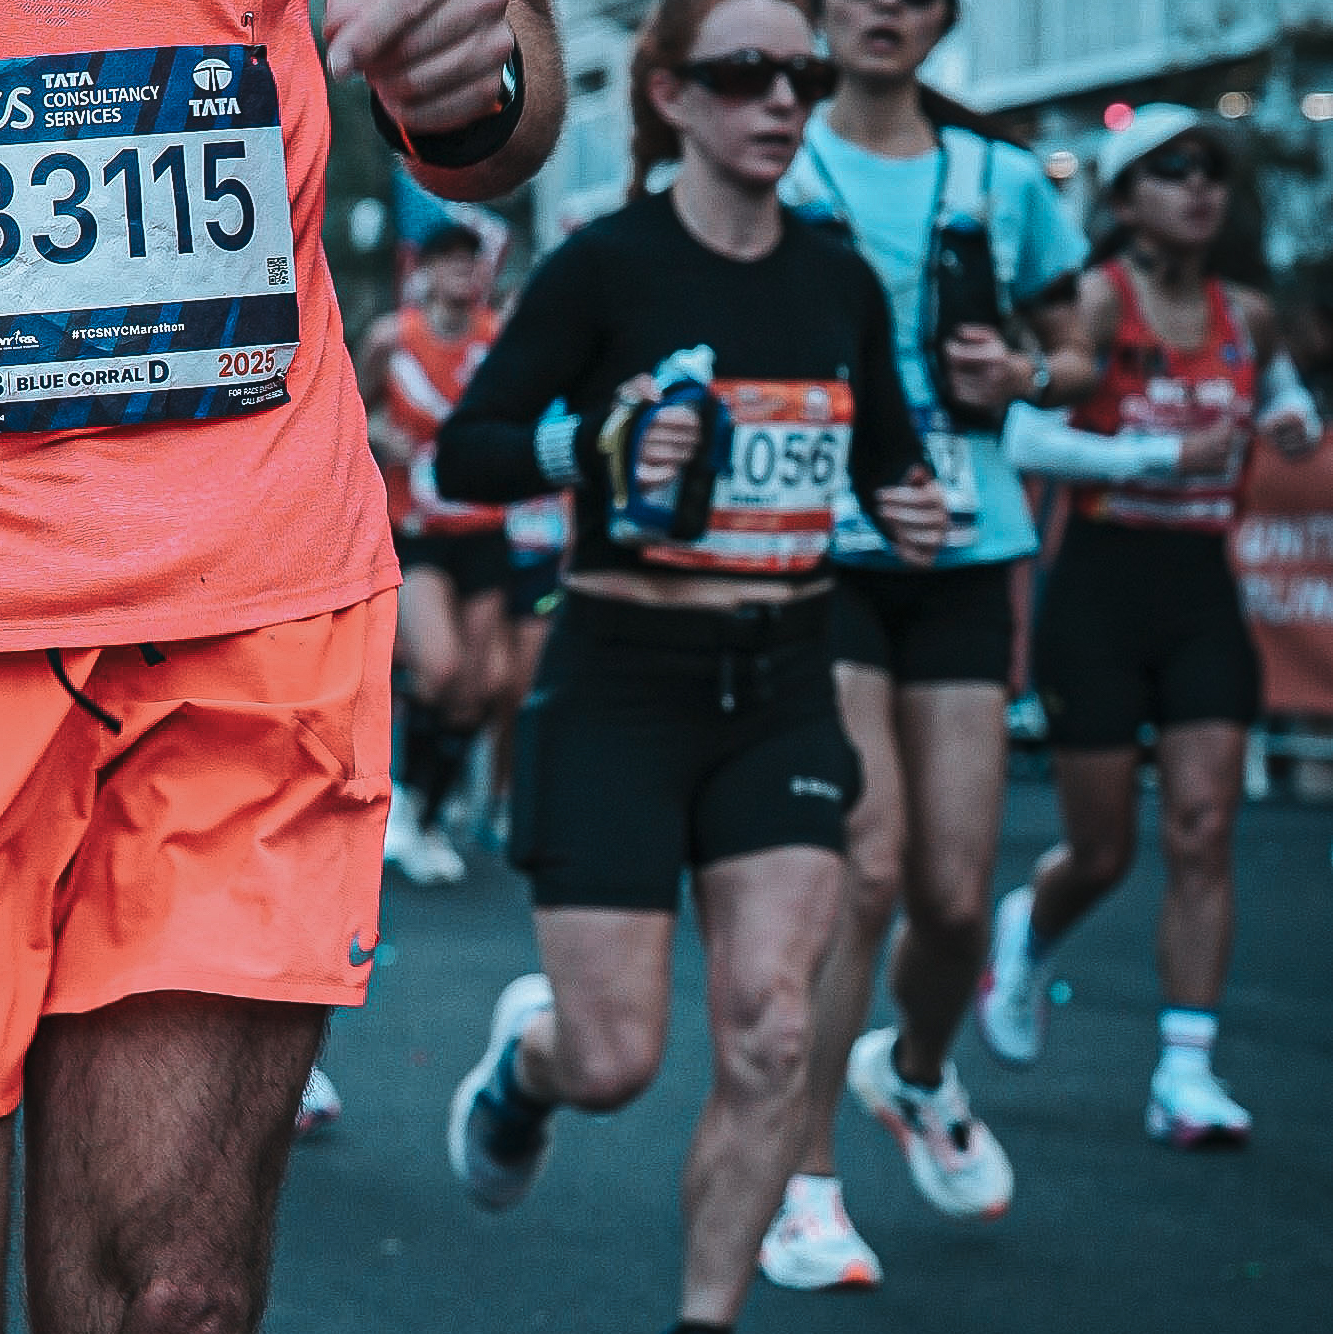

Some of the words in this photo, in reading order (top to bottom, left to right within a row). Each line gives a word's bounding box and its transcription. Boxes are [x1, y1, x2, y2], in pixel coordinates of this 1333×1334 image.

[41, 71, 94, 89] TATA
[43, 85, 160, 109] CONSULTANCY
[188, 97, 242, 118] TATA
[44, 107, 122, 129] SERVICES
[71, 322, 185, 340] #TCSNYCMarathon
[218, 348, 276, 378] 2025
[16, 373, 64, 392] BLUE
[67, 367, 145, 387] CORRAL
[149, 359, 170, 384] D
[228, 388, 242, 397] FOR
